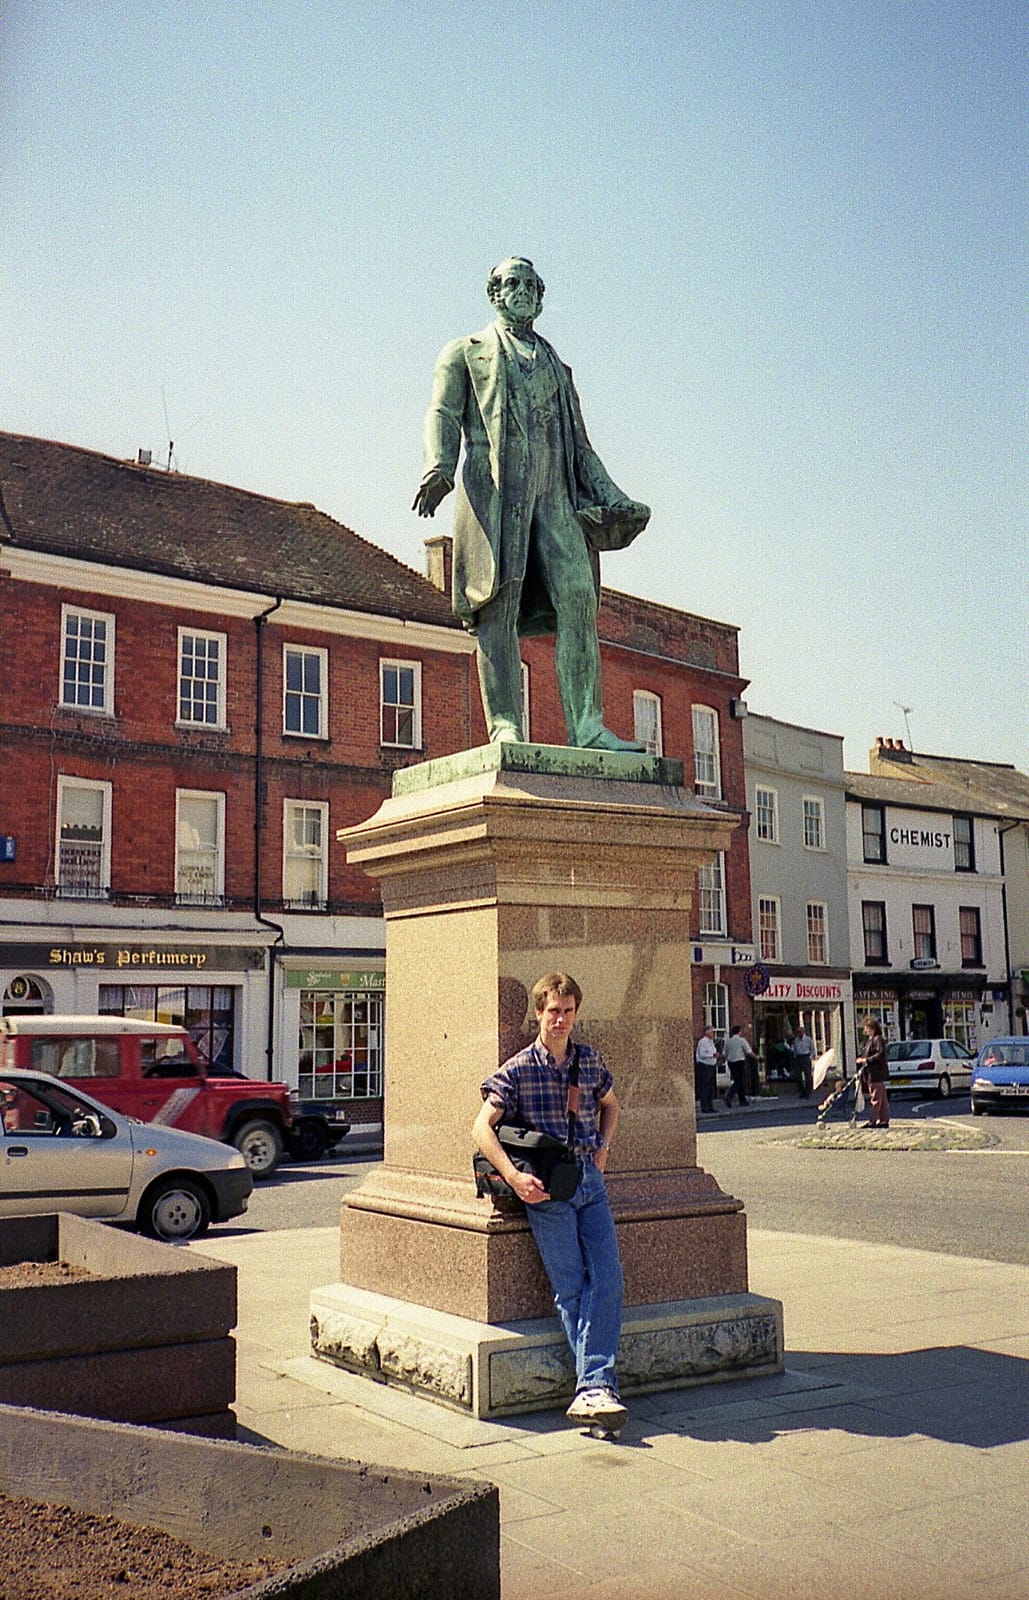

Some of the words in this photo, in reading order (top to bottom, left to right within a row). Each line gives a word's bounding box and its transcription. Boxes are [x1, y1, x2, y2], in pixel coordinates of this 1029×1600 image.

[890, 828, 950, 848] CHEMIST
[49, 948, 105, 965] Shaw's
[116, 950, 206, 969] Perfumery
[760, 984, 792, 998] LITY
[796, 982, 842, 998] DISCOUNTS
